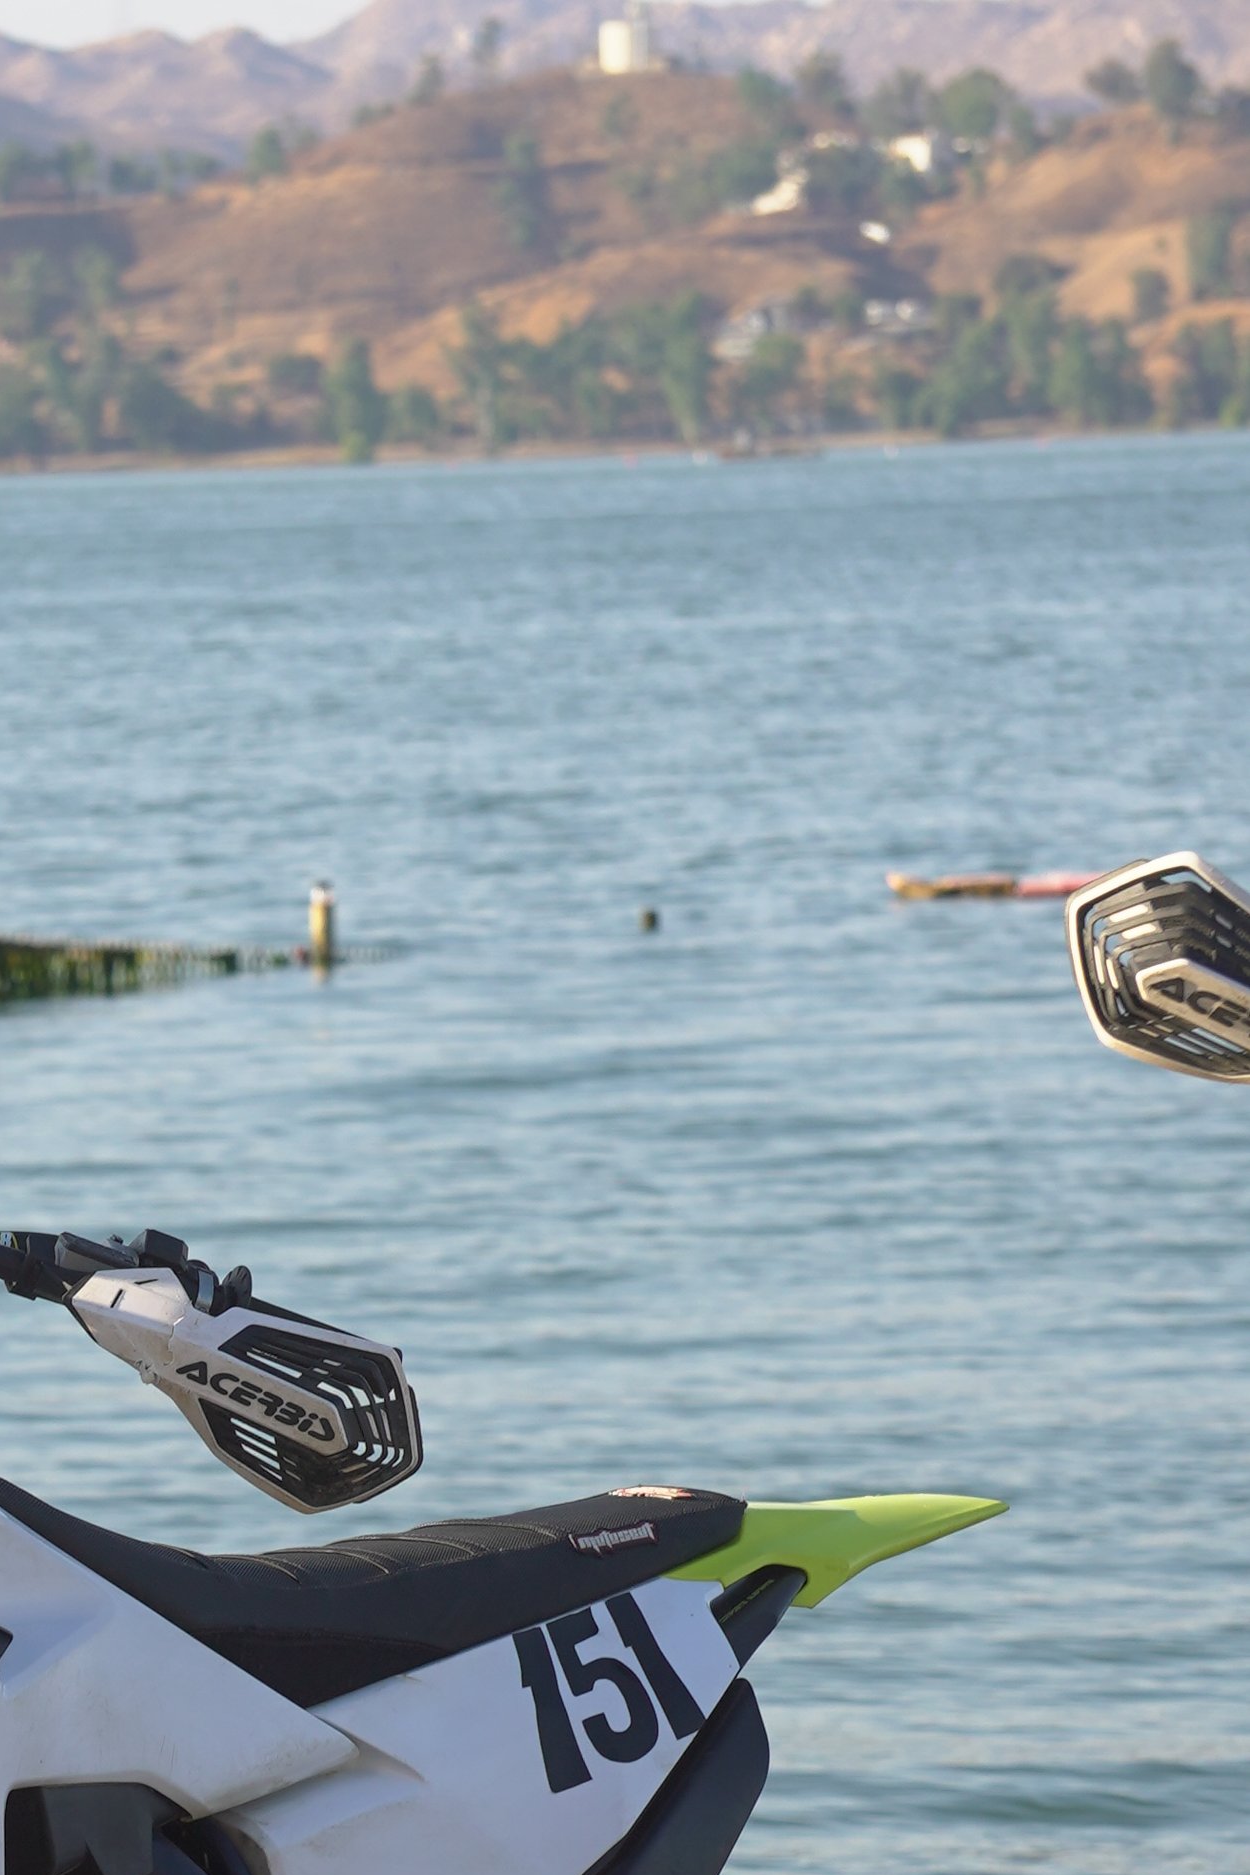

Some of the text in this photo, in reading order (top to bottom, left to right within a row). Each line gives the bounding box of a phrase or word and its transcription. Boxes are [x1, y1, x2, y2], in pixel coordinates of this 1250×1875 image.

[1151, 977, 1250, 1036] ACE
[176, 1361, 335, 1442] ACERBIS
[512, 1592, 706, 1793] 151
